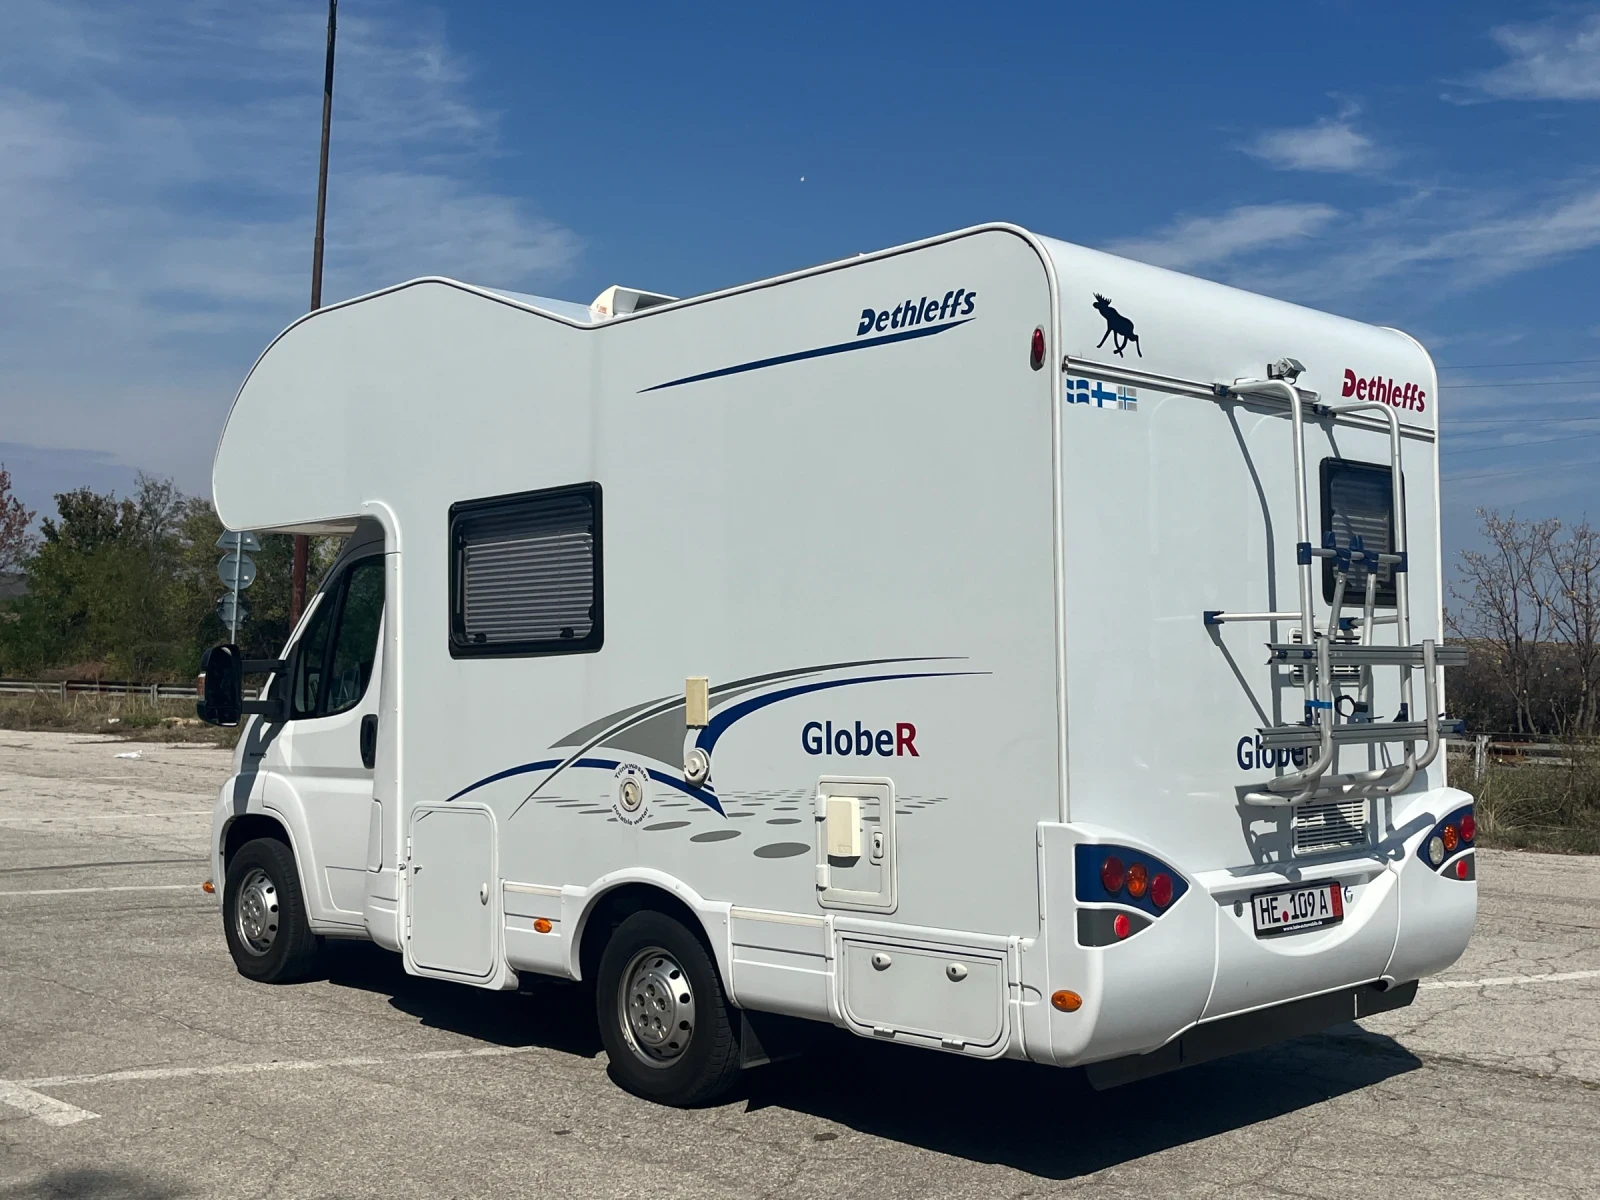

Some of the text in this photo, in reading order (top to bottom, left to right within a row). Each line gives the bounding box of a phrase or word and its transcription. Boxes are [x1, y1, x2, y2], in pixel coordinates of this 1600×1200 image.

[857, 288, 976, 336] Dethleffs
[1342, 368, 1426, 413] Dethleffs
[801, 721, 920, 757] GlobeR
[614, 763, 649, 782] Trinkwasser
[633, 806, 649, 825] water
[1320, 889, 1329, 915] A
